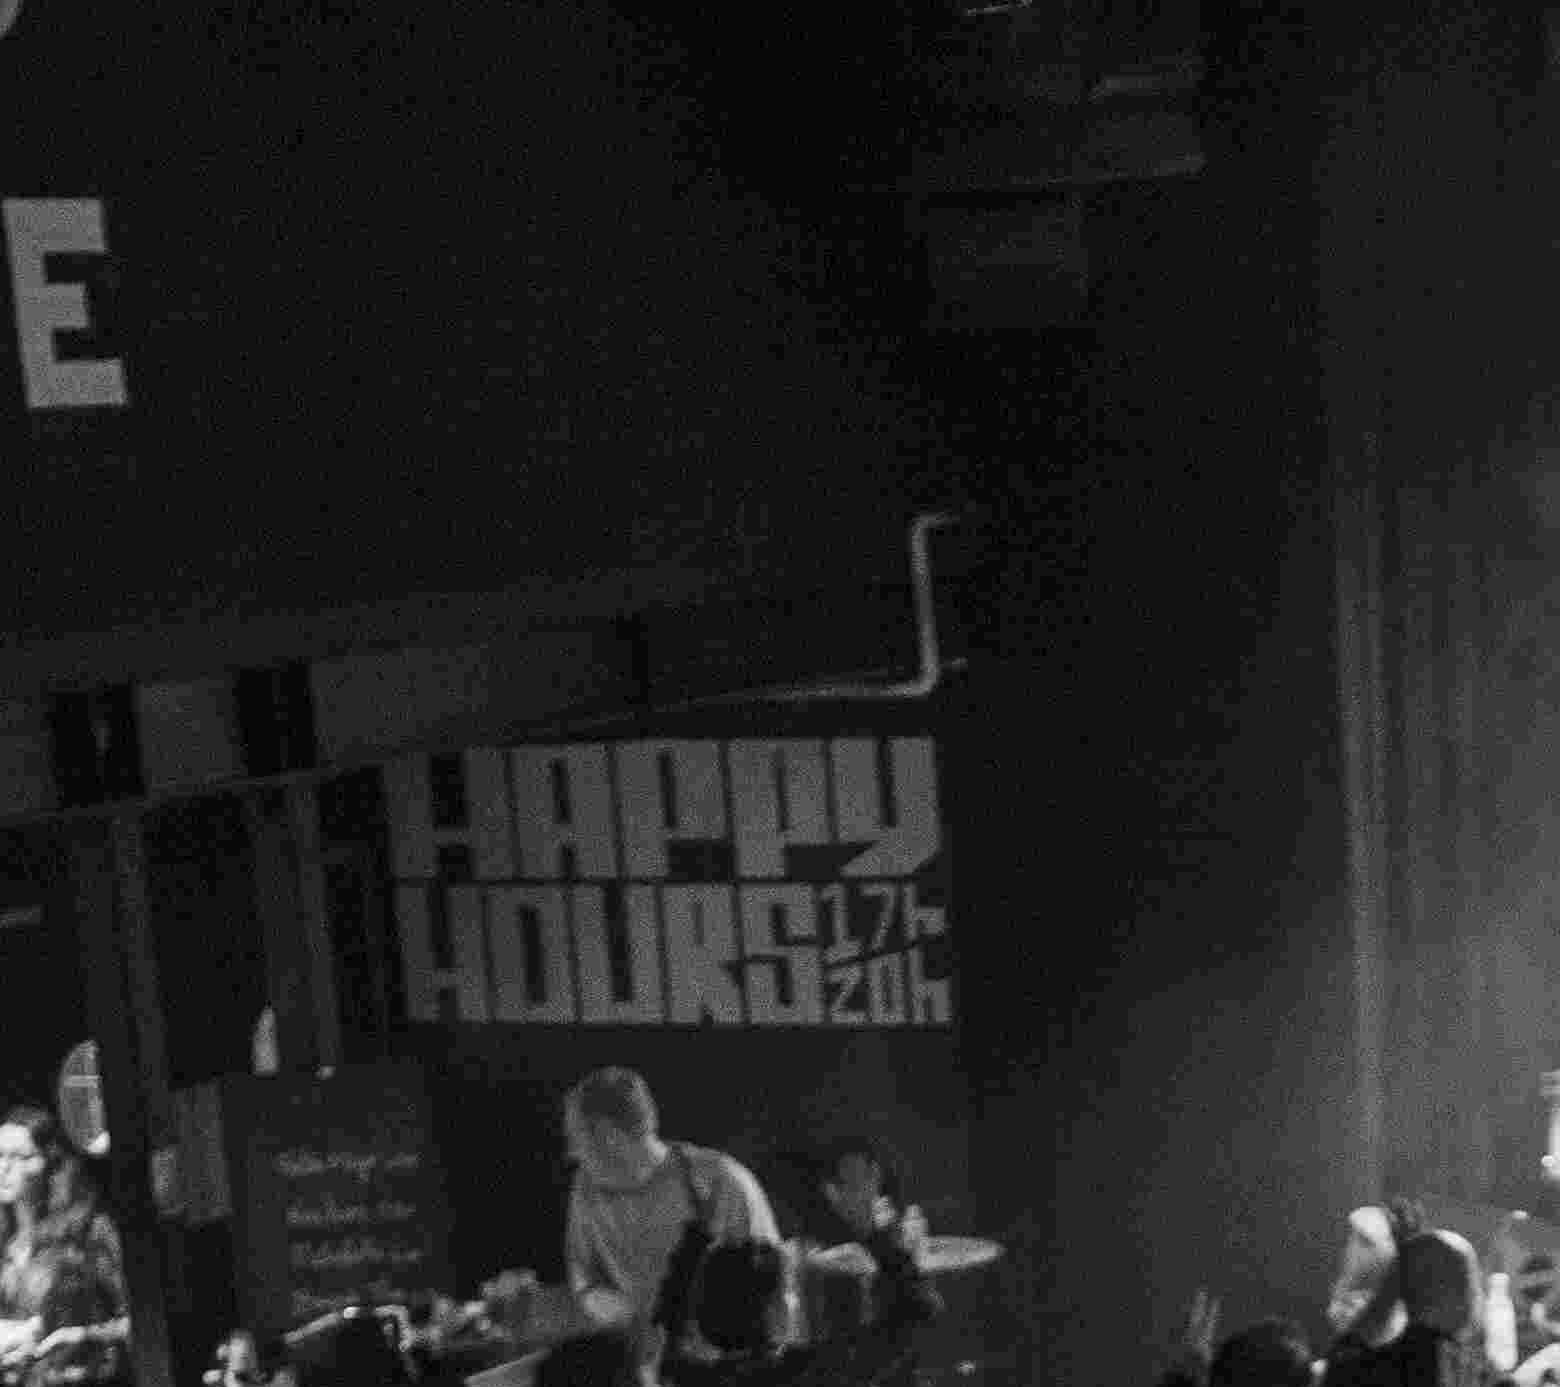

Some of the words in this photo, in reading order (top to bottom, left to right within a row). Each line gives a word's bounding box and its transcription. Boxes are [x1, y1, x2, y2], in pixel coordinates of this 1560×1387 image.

[382, 736, 943, 879] HAPPY
[393, 882, 826, 1025] HOURS
[821, 882, 946, 962] 17h
